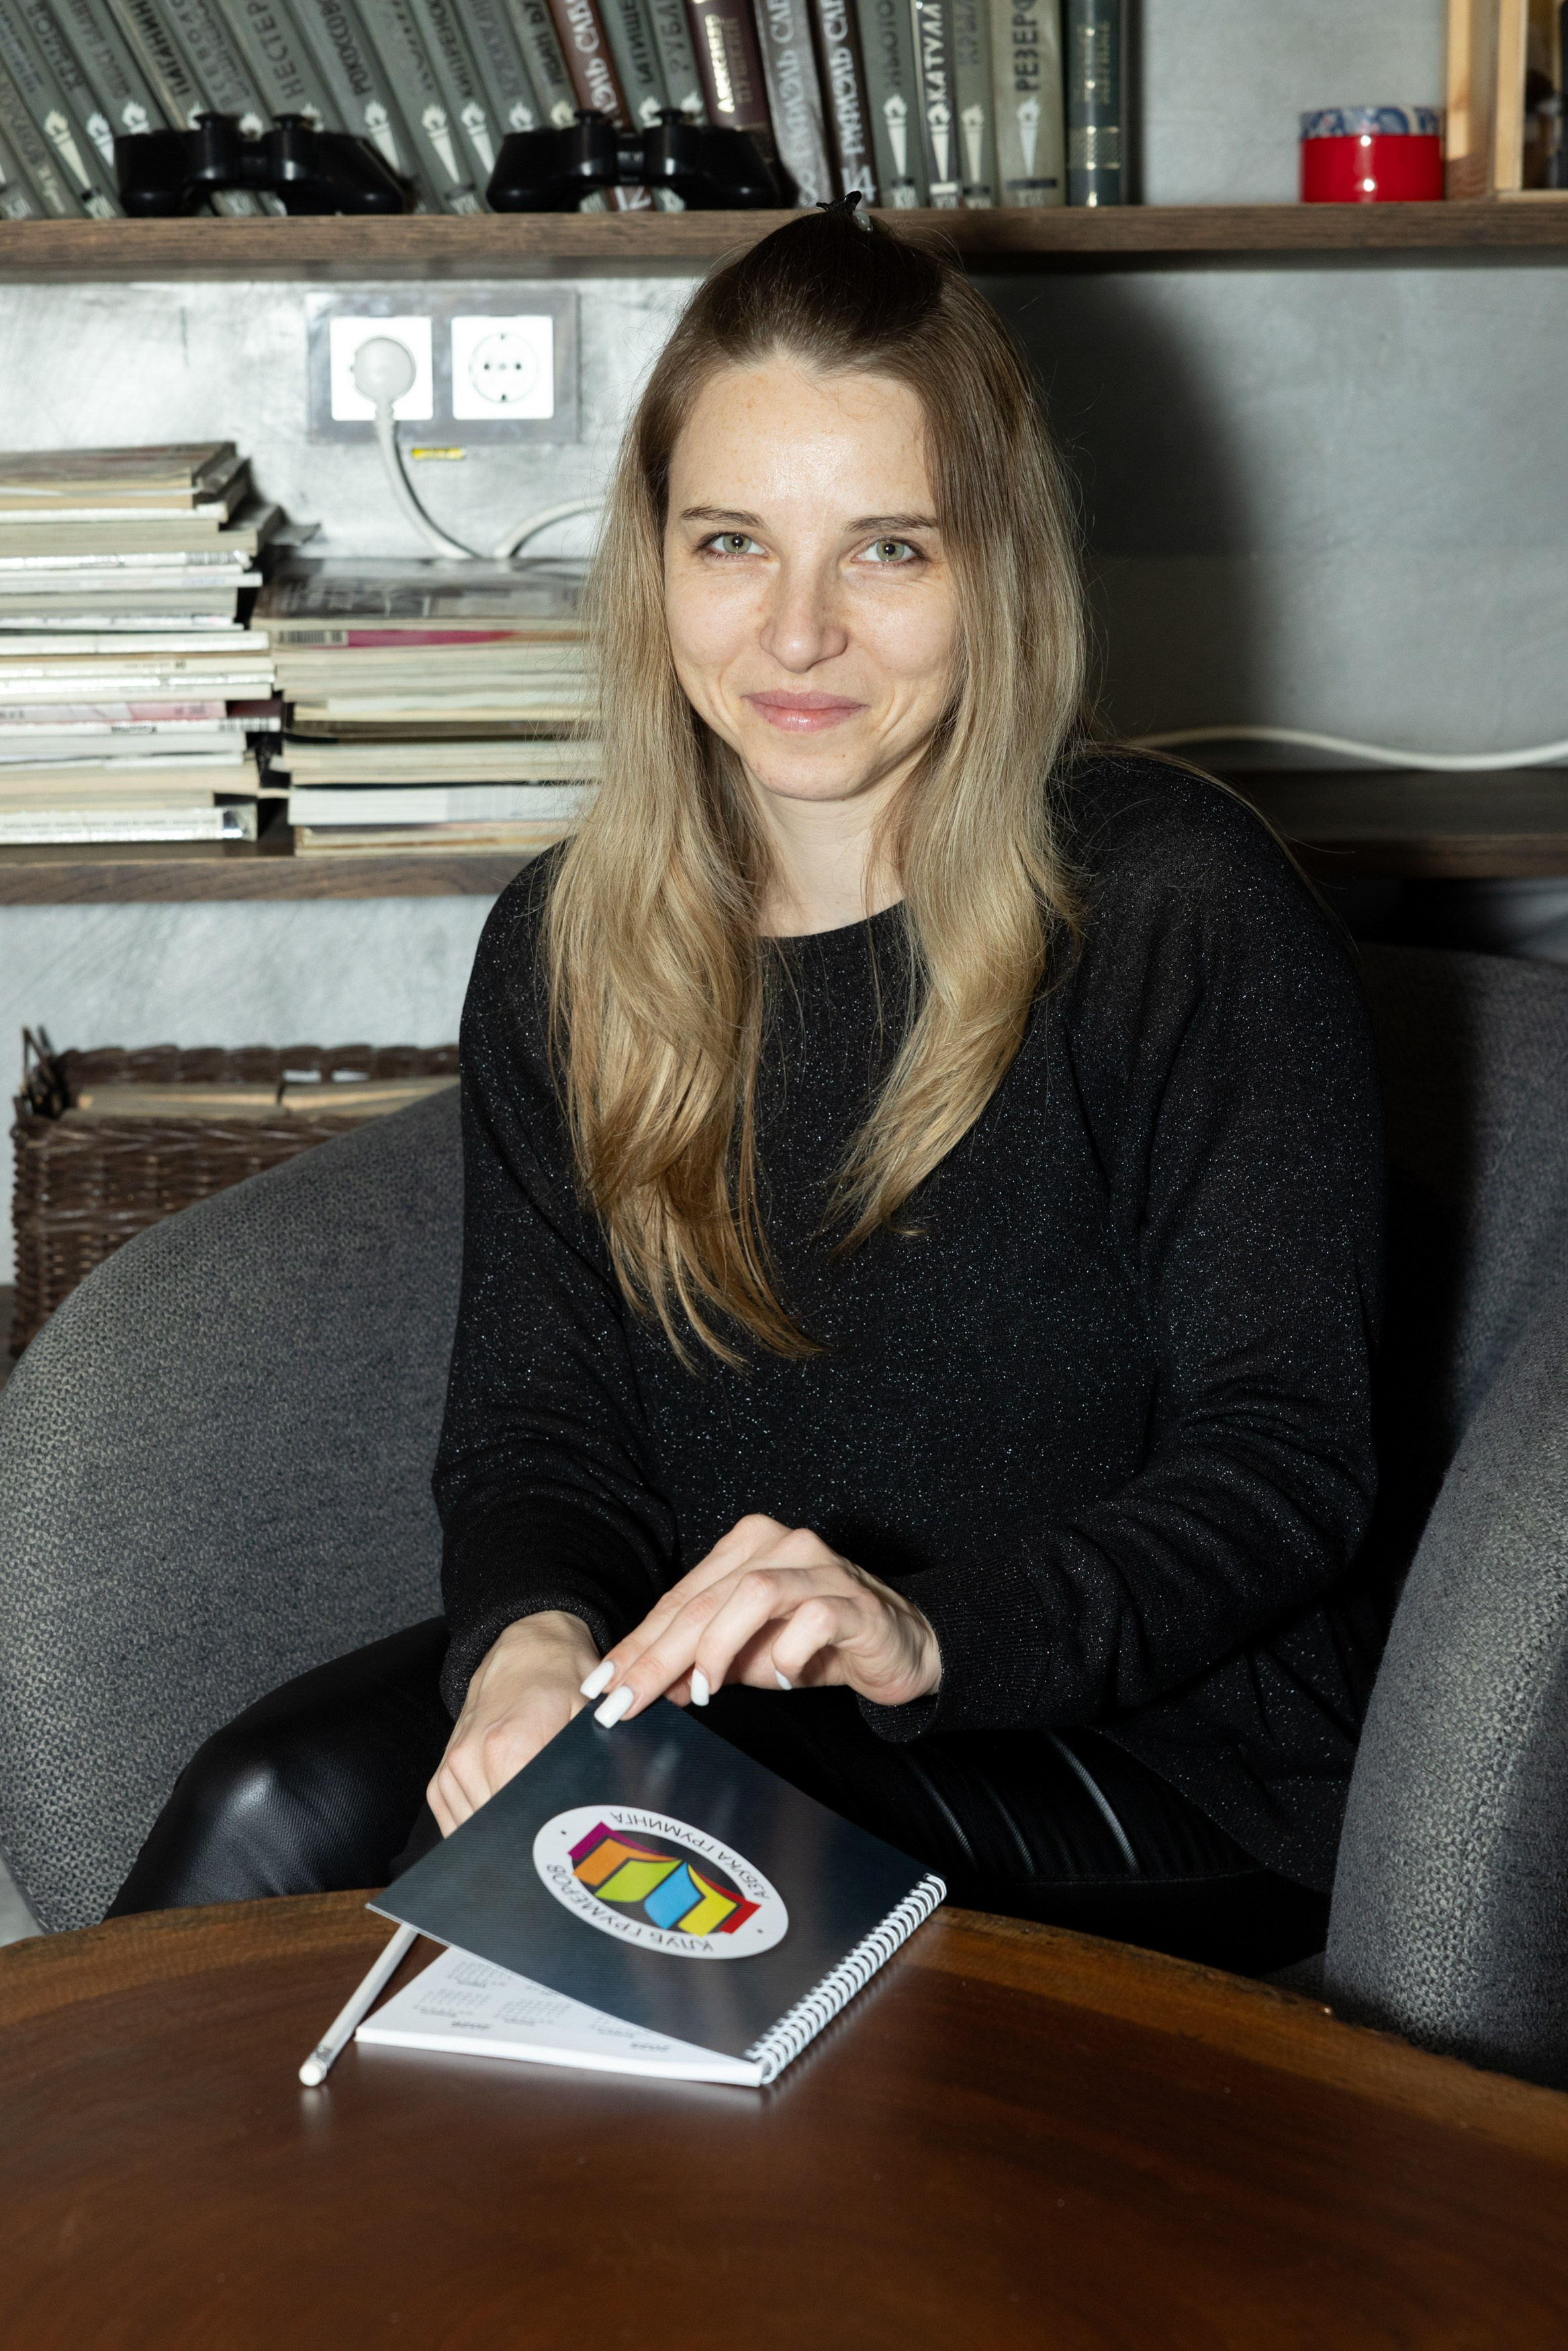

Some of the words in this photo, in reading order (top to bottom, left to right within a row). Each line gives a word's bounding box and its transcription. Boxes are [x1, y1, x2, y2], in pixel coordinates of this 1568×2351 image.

[242, 0, 307, 101] НЕСТЕР
[563, 0, 602, 55] САБ
[921, 3, 946, 101] КАТУЛЛ
[610, 1812, 711, 1853] ГРУМИНГА
[547, 1863, 642, 1937] ГРУМЕРОВ
[718, 1851, 771, 1900] АЗБУКА
[651, 1932, 714, 1953] КЛУБ
